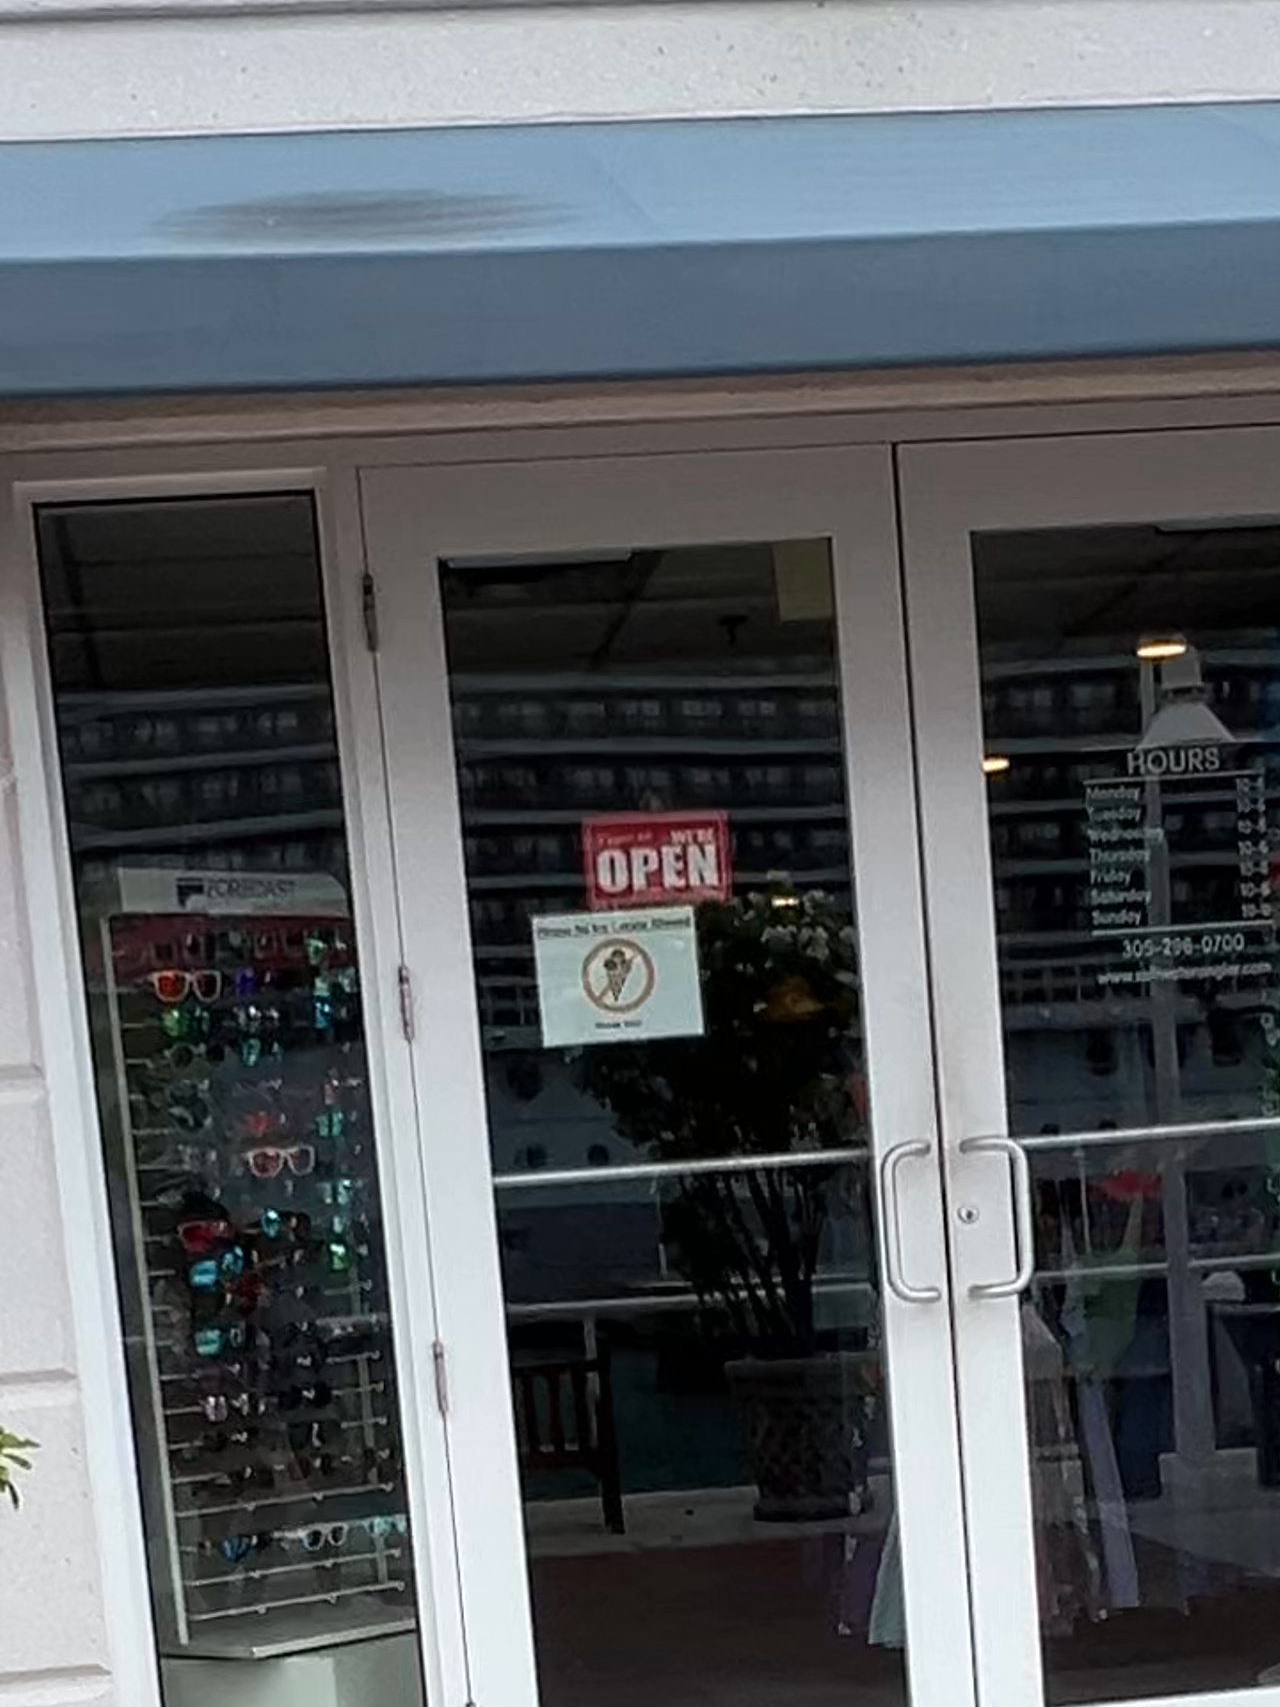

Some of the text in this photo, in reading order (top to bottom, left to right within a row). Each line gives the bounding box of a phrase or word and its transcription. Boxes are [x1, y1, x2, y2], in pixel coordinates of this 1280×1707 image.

[1127, 747, 1220, 775] HOURS
[597, 843, 719, 893] OPEN
[1123, 933, 1245, 958] 305-296-0700
